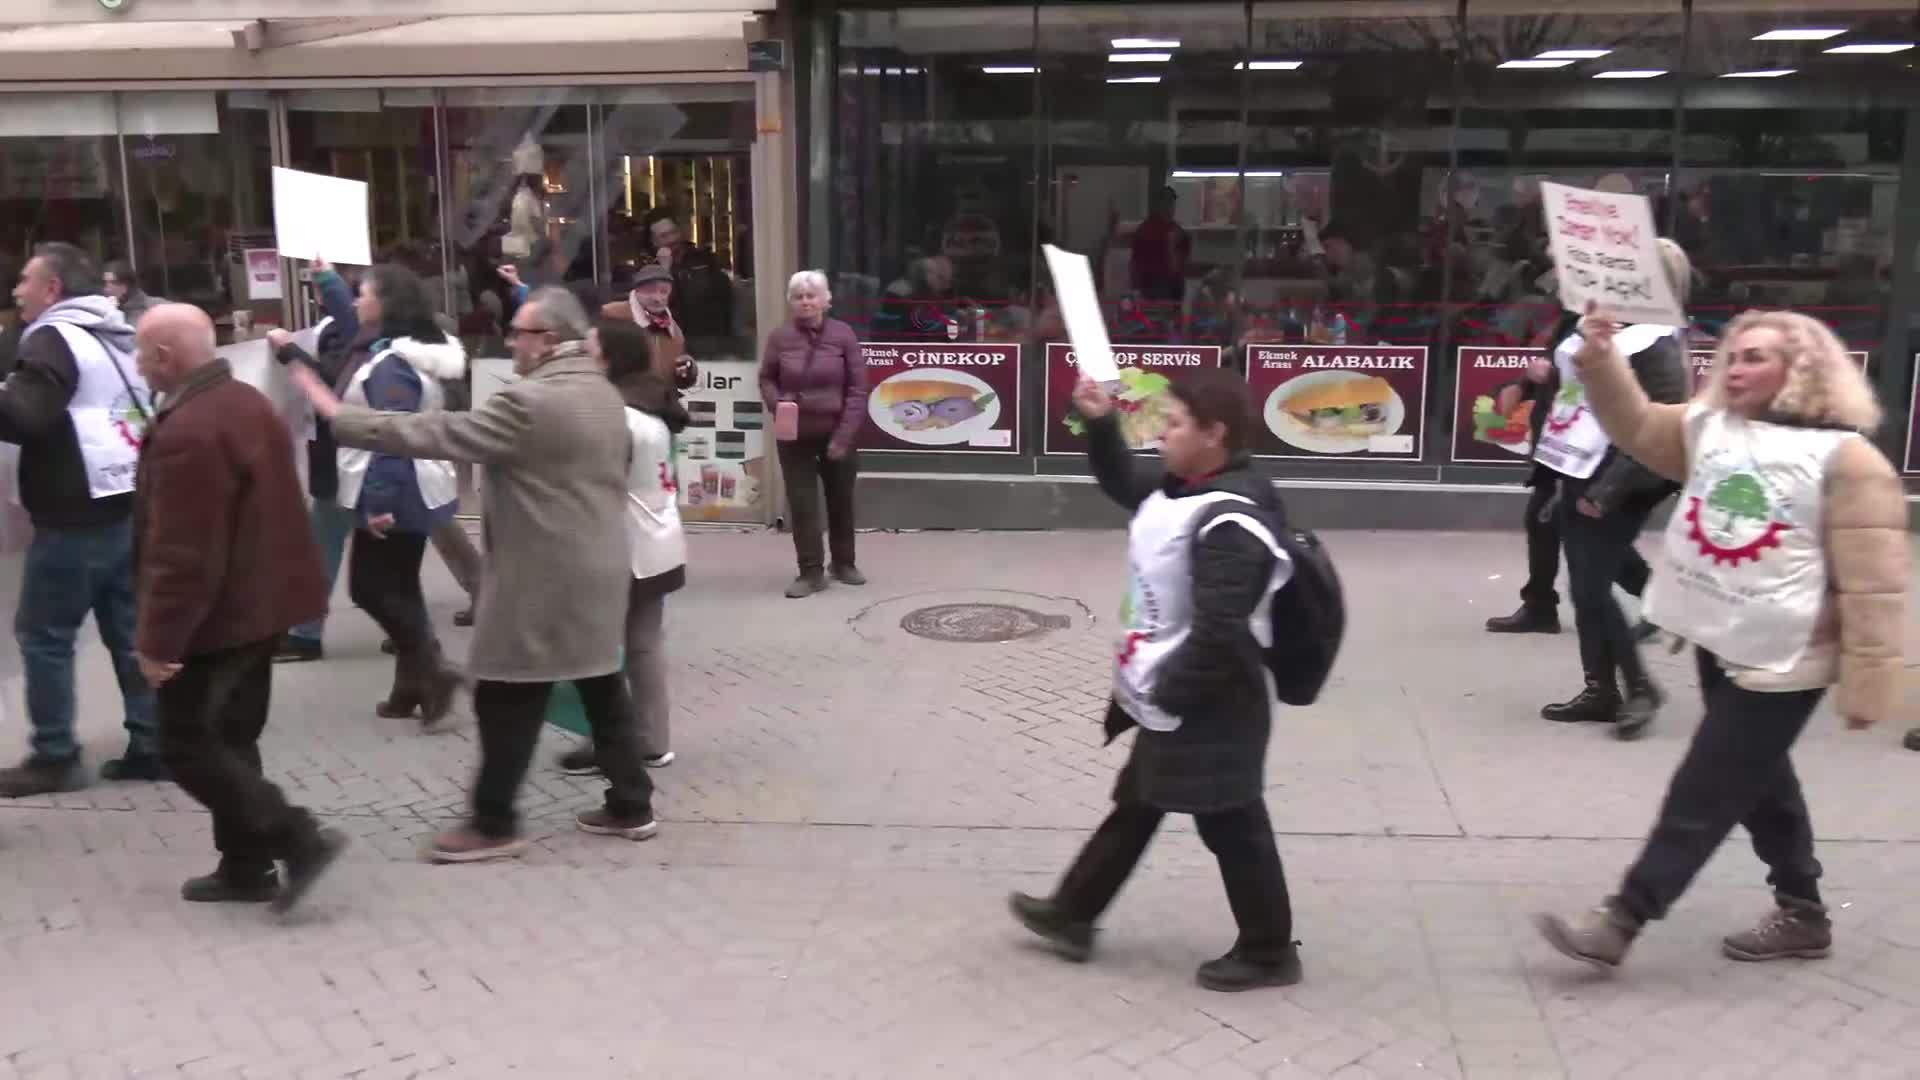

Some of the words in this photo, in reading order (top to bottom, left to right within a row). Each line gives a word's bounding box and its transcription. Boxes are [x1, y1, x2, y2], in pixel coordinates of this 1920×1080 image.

[861, 349, 899, 358] Ekmek
[902, 350, 1006, 368] ÇİNEKOP
[1142, 351, 1201, 366] SERVİS
[1258, 351, 1298, 361] Ekmek
[866, 357, 894, 366] Arası
[1263, 360, 1292, 369] Arası
[1302, 355, 1415, 369] ALABALIK
[1473, 354, 1536, 369] ALABA
